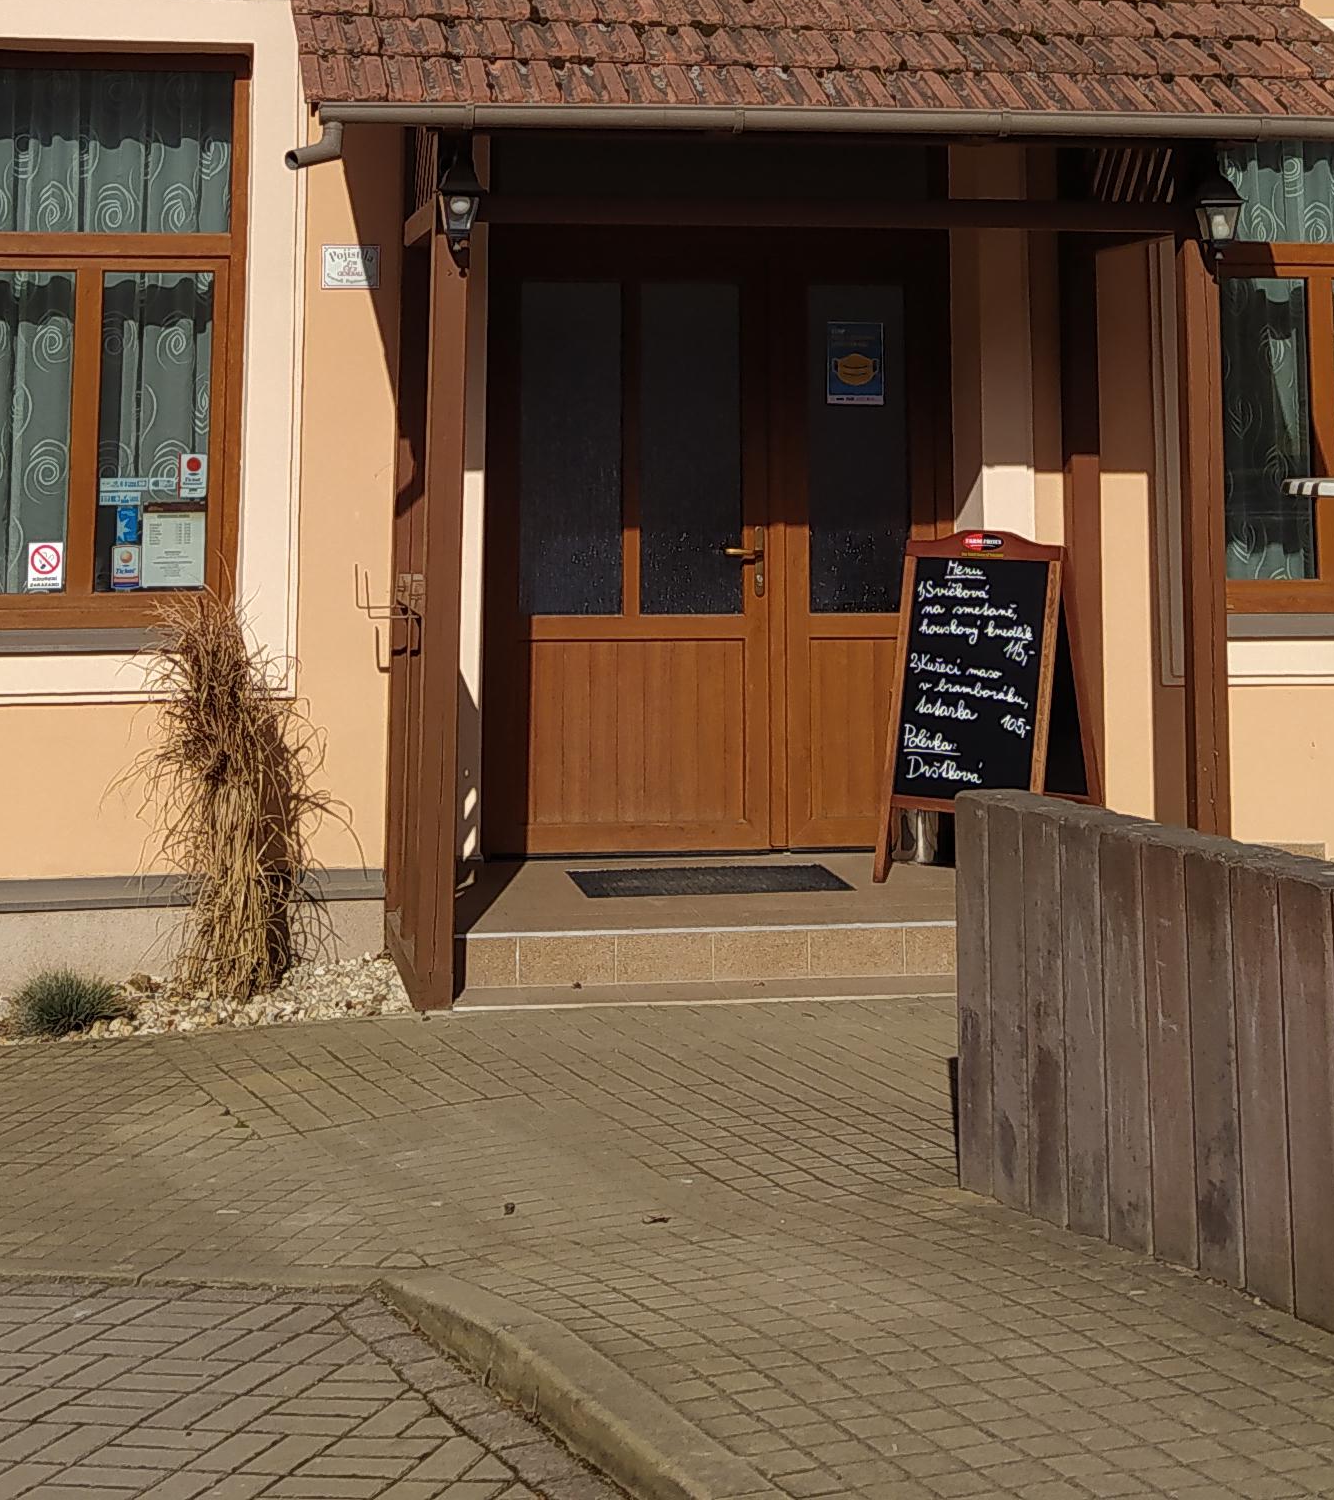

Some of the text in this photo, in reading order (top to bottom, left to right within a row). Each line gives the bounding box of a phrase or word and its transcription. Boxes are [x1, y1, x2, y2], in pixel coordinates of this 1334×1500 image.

[946, 560, 984, 575] Menu
[921, 604, 946, 615] na
[918, 618, 1034, 645] houskový knedlík
[965, 667, 1003, 679] maso
[918, 681, 933, 691] v
[914, 694, 979, 720] tatarka
